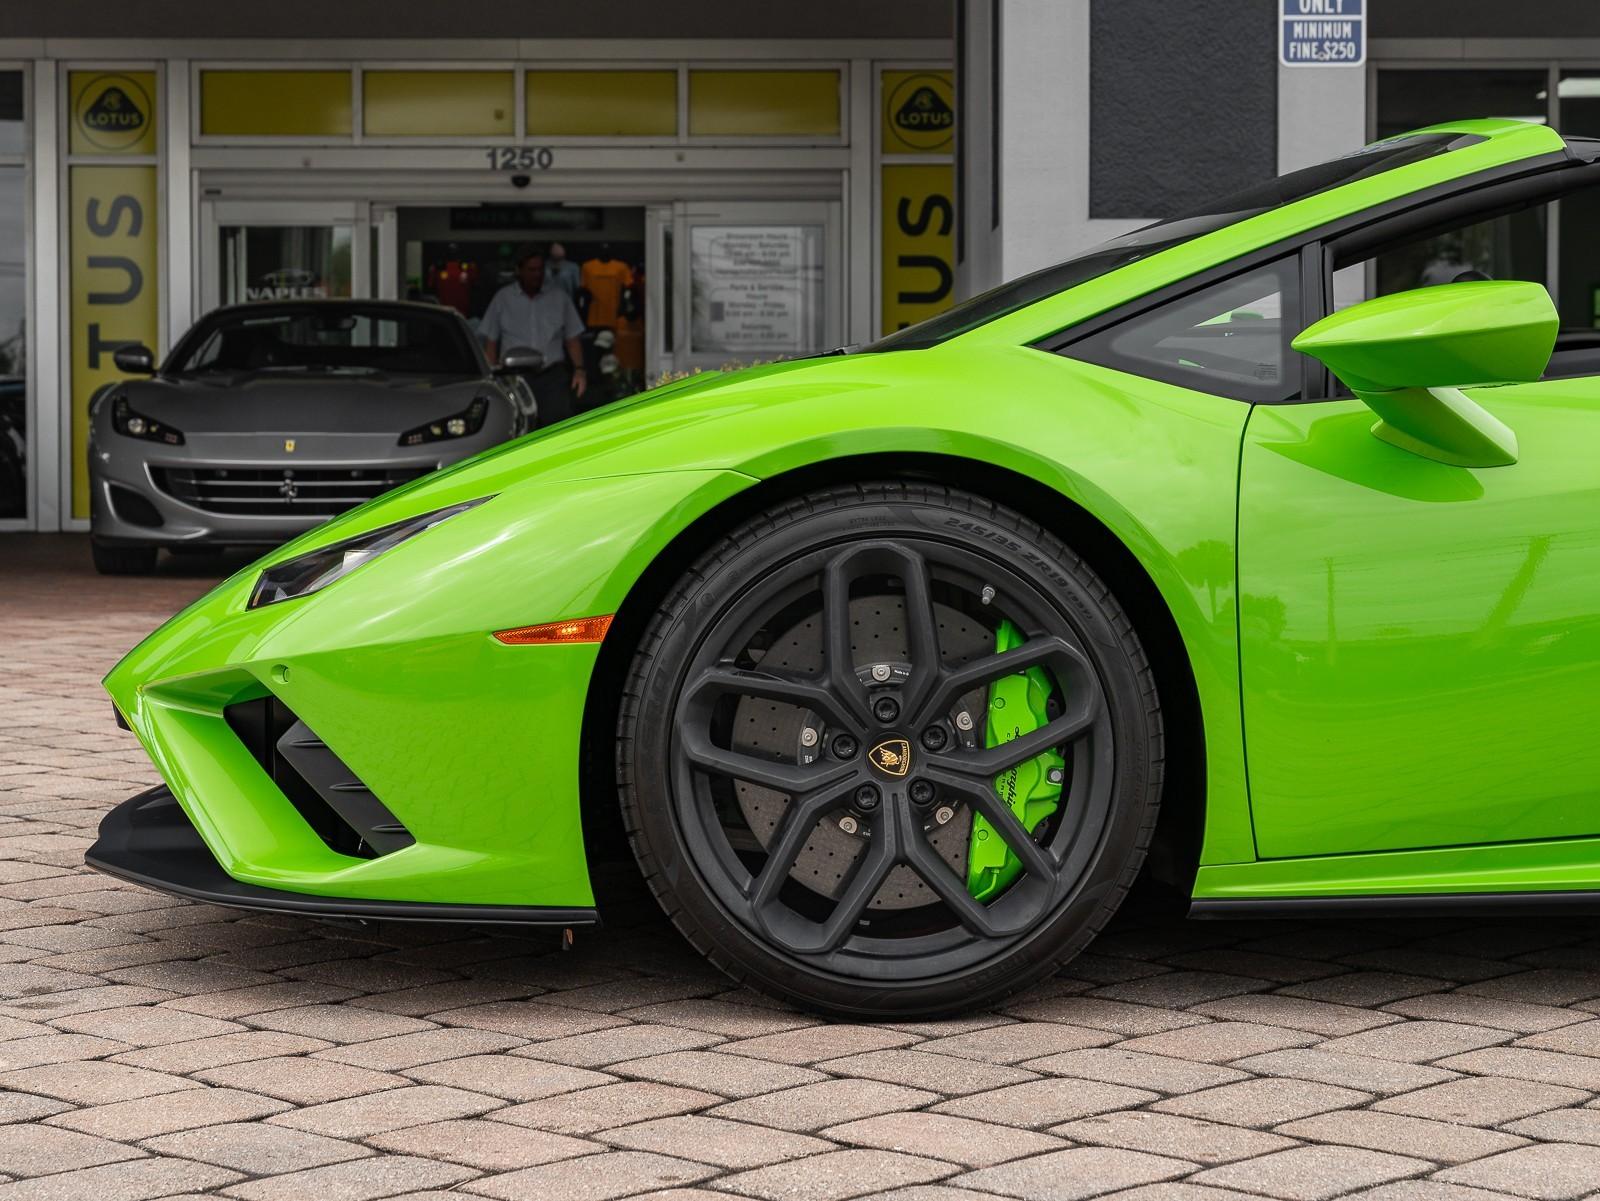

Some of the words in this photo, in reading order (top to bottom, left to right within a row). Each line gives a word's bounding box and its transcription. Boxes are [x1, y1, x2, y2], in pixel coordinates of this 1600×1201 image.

[1298, 0, 1344, 14] ONLY
[1293, 21, 1352, 39] MINIMUM
[1289, 41, 1319, 59] FINE
[1323, 40, 1356, 61] $250
[87, 112, 140, 126] LOTUS
[900, 111, 952, 125] LOTUS
[486, 147, 554, 170] 1250
[246, 286, 328, 300] NAPLES
[944, 516, 1022, 552] 245/35
[1021, 551, 1070, 589] ZR19
